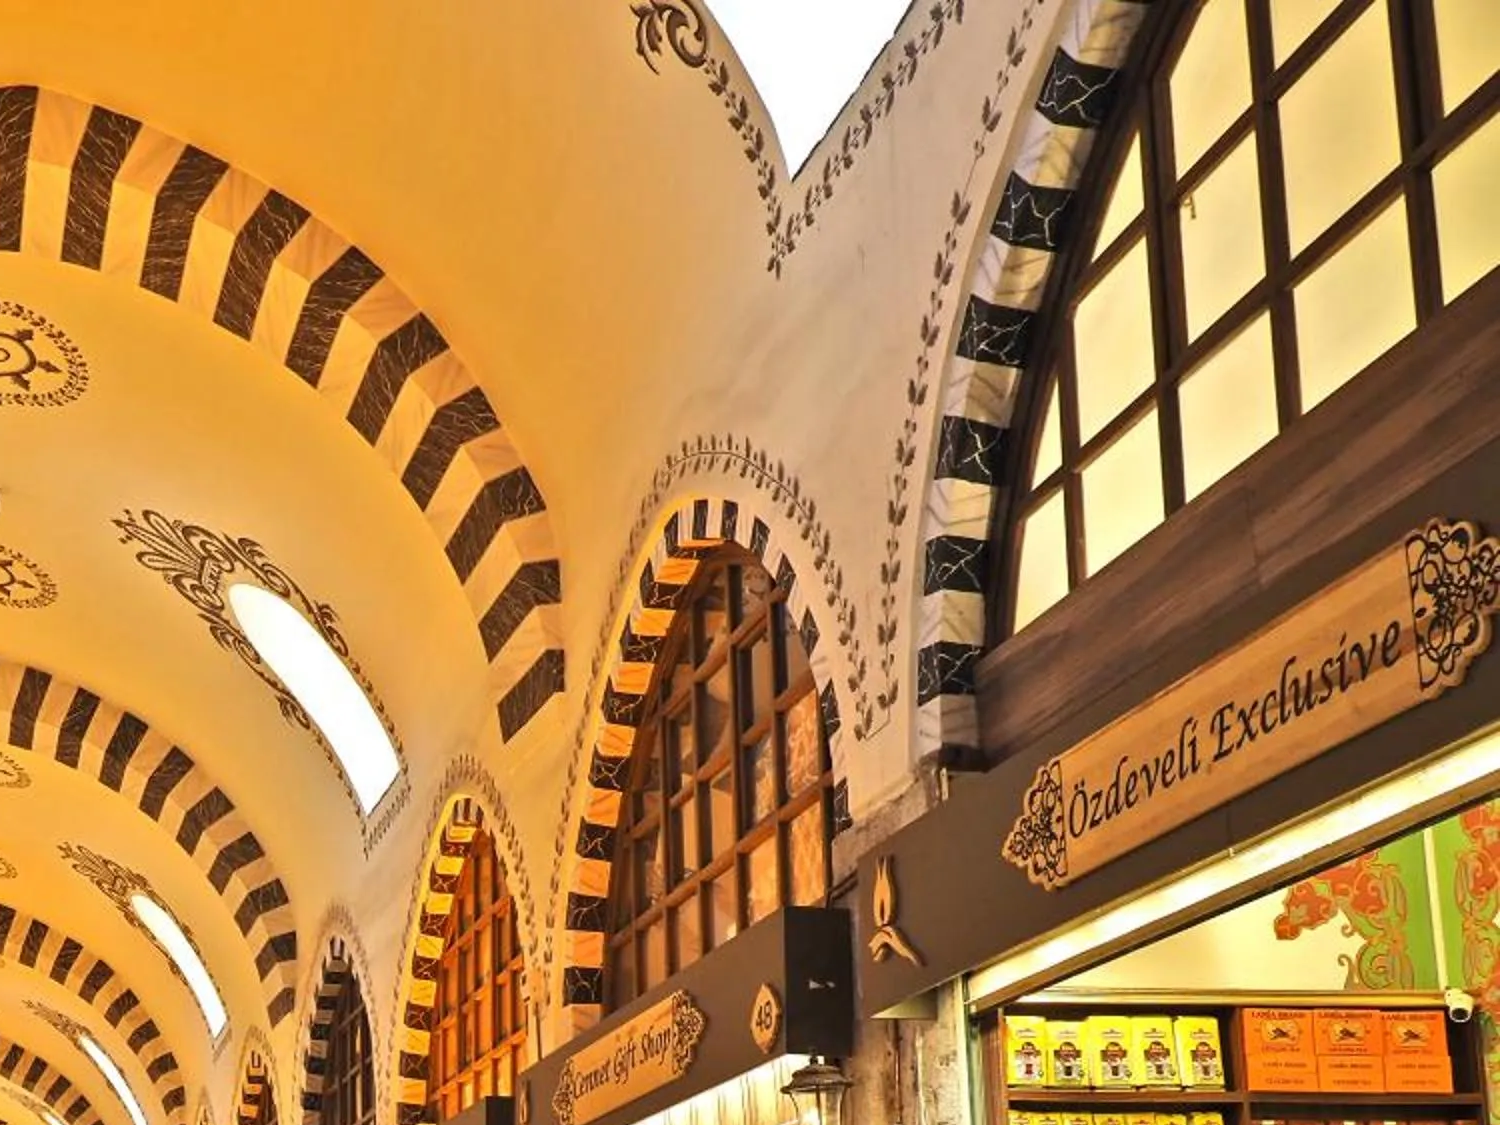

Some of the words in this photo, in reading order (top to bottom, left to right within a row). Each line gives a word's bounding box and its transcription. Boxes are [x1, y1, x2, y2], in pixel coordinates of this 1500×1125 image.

[1068, 716, 1201, 839] Özdeveli
[1209, 619, 1401, 763] Exclusive
[755, 1001, 773, 1032] 48
[612, 1038, 638, 1085] Gift
[638, 1023, 672, 1067] Shop
